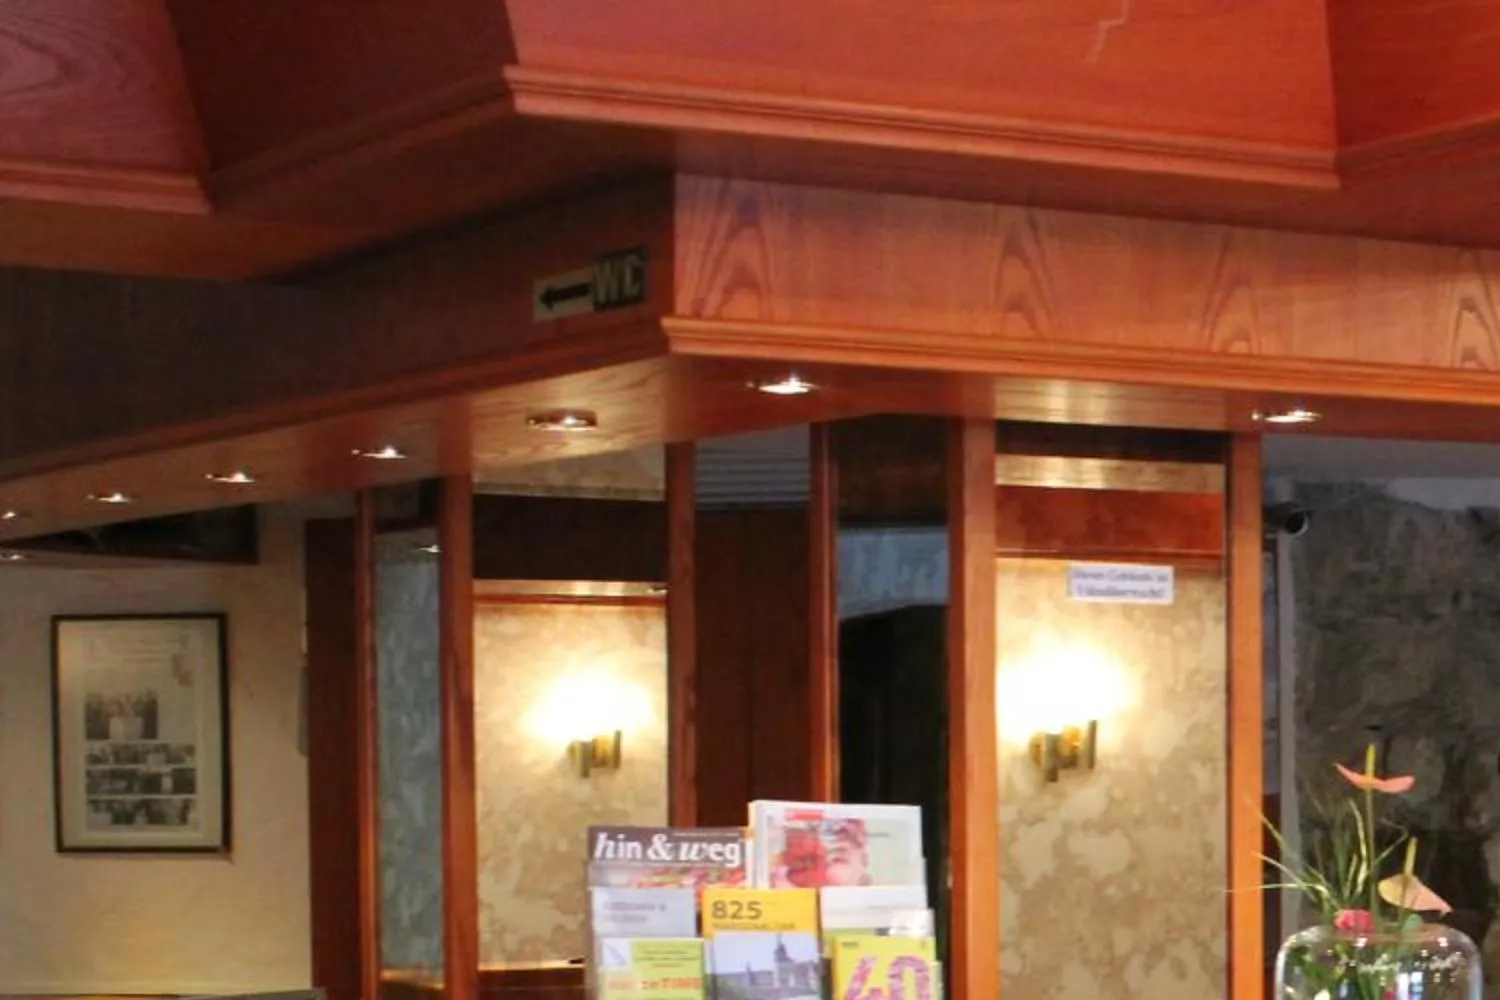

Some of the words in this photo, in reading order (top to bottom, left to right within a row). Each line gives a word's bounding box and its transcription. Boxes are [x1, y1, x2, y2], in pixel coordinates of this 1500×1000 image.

[594, 255, 641, 303] WC
[594, 832, 642, 859] hin
[646, 833, 674, 861] &
[678, 841, 741, 868] weg
[711, 899, 763, 920] 825
